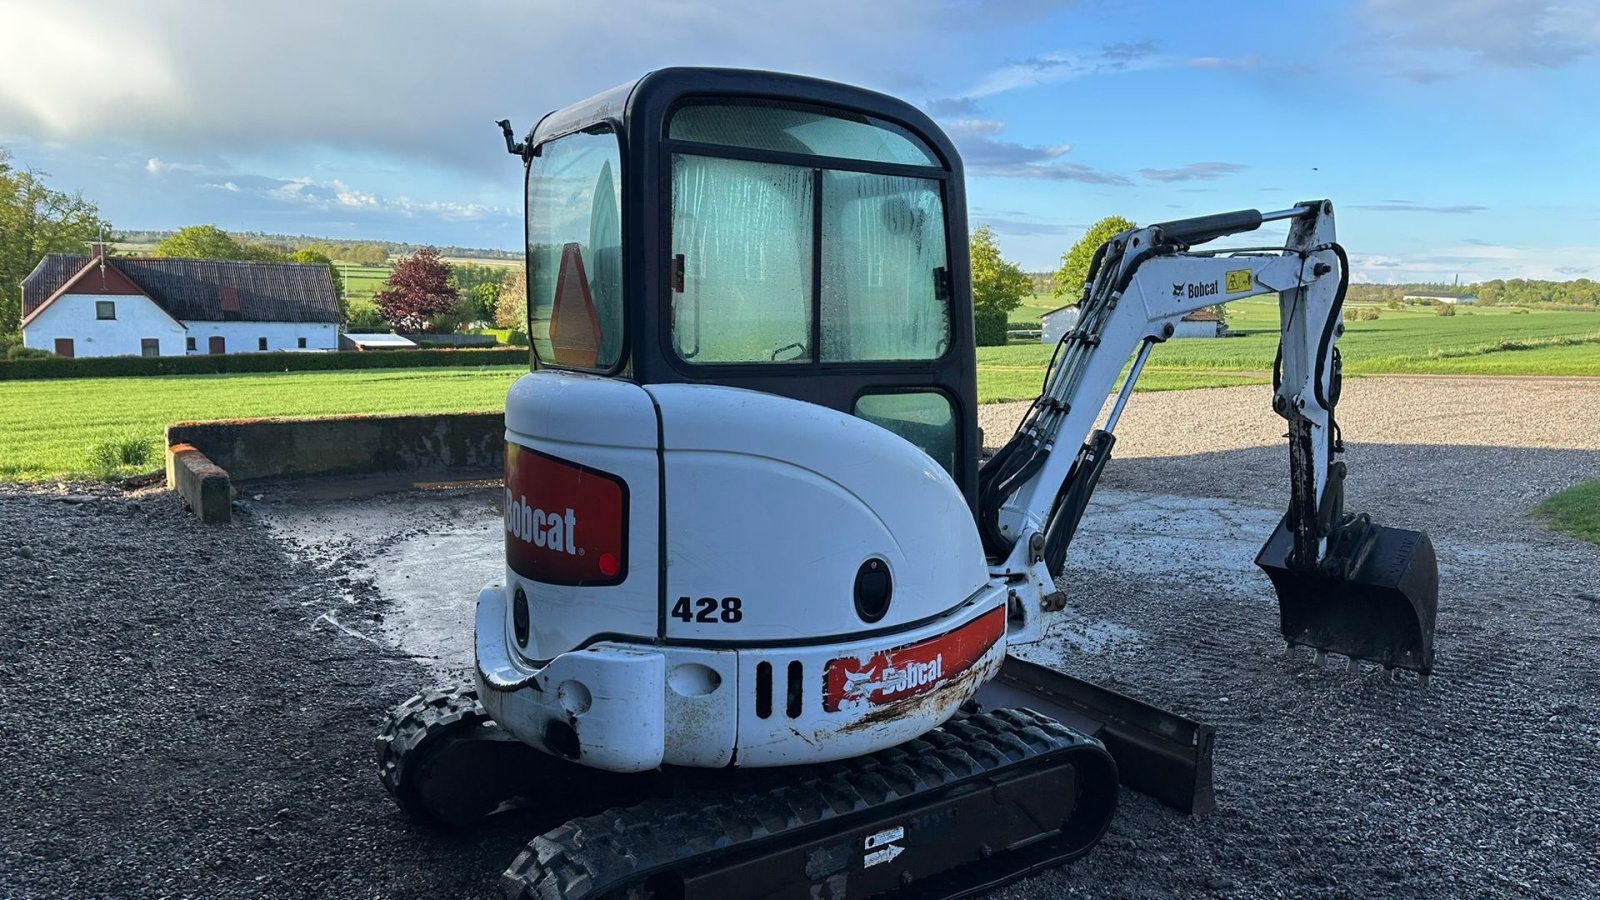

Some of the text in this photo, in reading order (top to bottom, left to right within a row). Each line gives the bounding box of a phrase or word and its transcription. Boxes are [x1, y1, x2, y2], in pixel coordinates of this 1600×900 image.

[1188, 280, 1218, 299] Bobcat
[505, 487, 576, 555] Bobcat
[671, 596, 743, 624] 428
